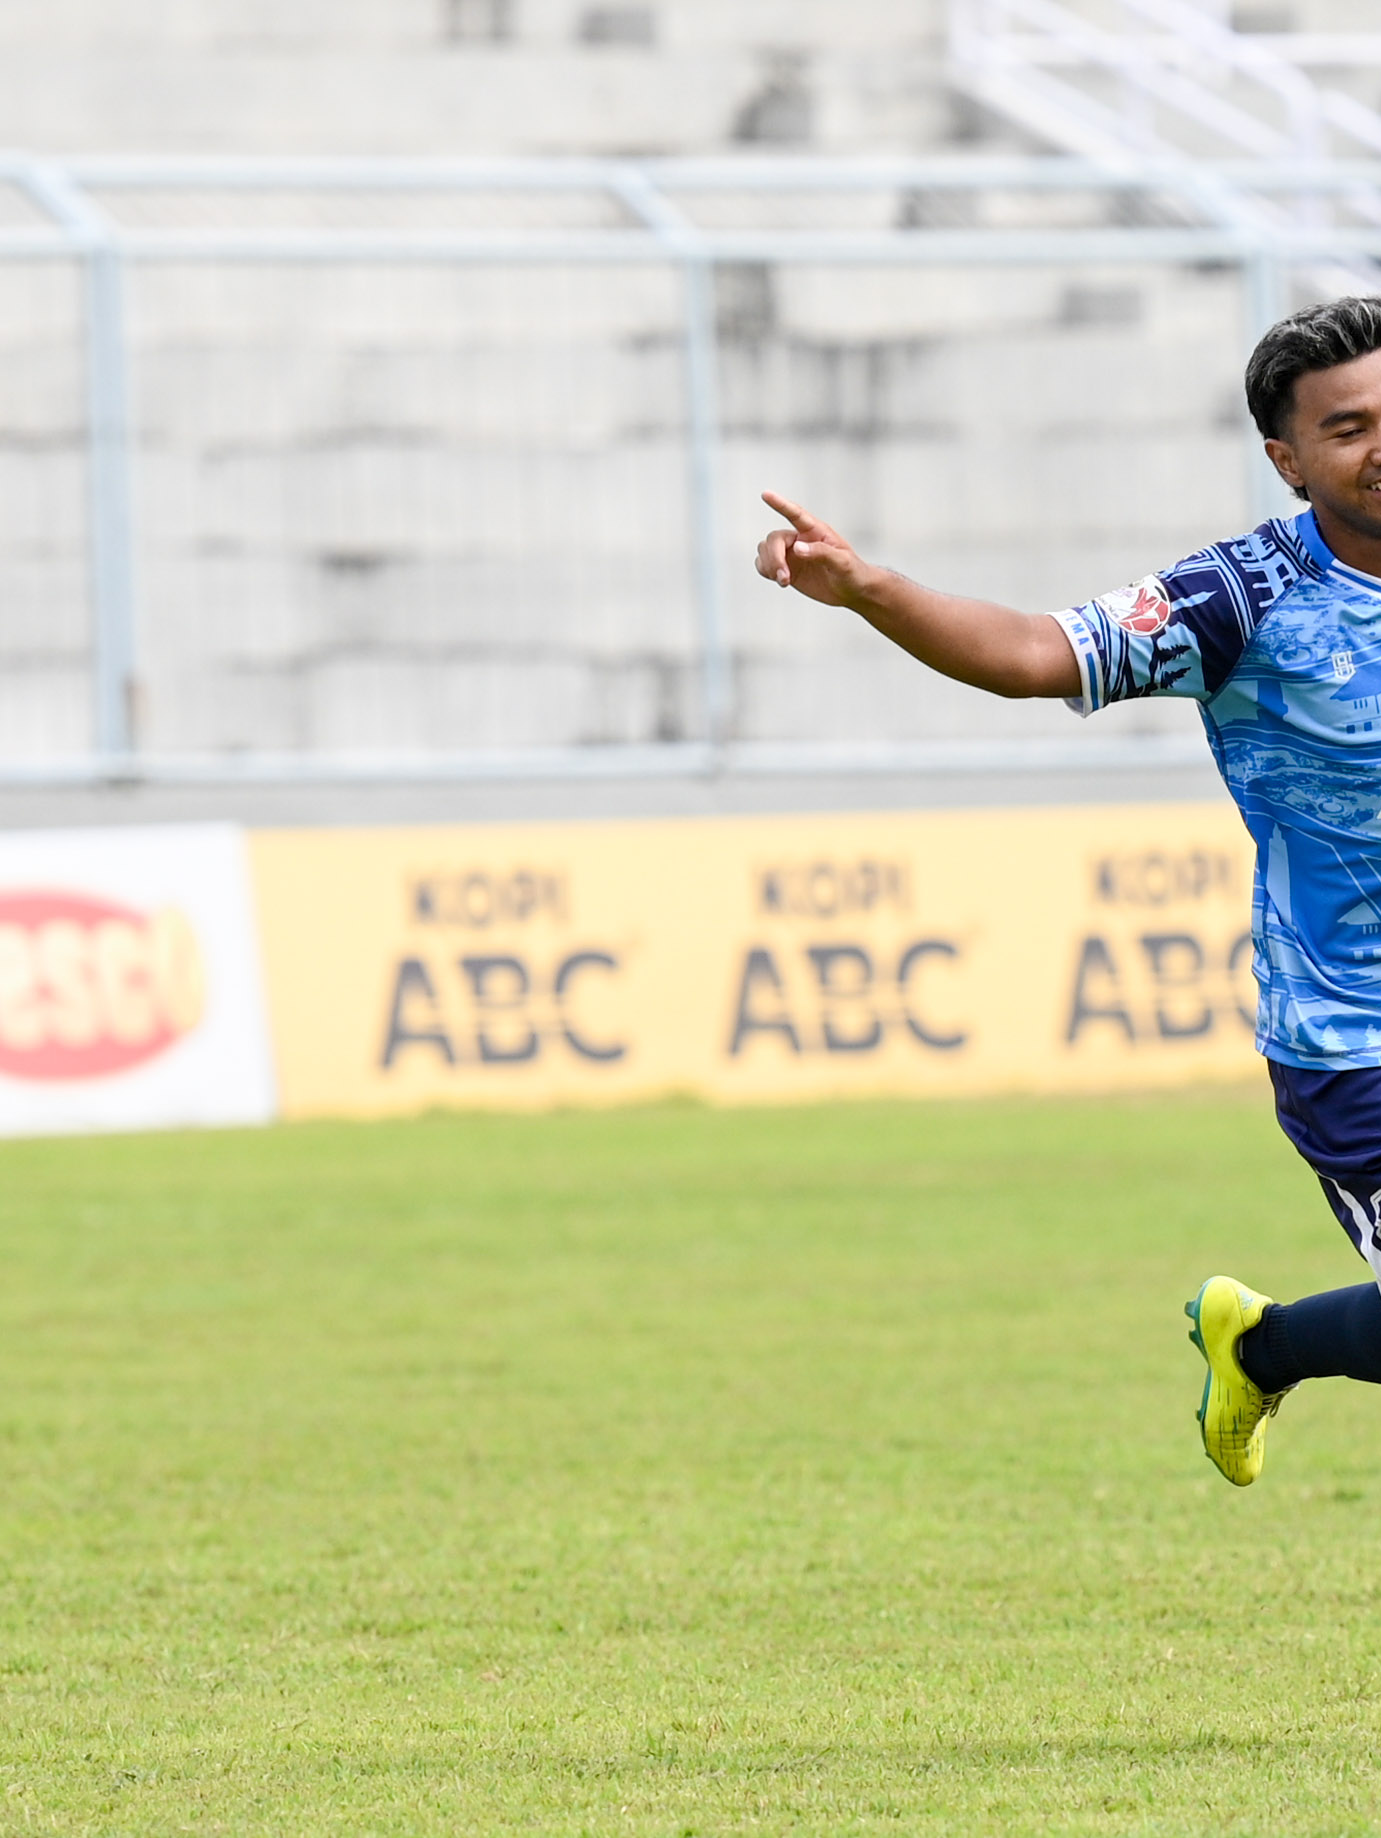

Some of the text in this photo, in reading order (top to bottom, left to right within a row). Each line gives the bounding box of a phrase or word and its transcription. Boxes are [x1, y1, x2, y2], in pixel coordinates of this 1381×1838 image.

[411, 869, 567, 927] KOPI
[758, 859, 908, 917] KOPI
[1094, 851, 1236, 908] KOPI
[377, 951, 627, 1070] ABC
[727, 940, 969, 1058] ABC
